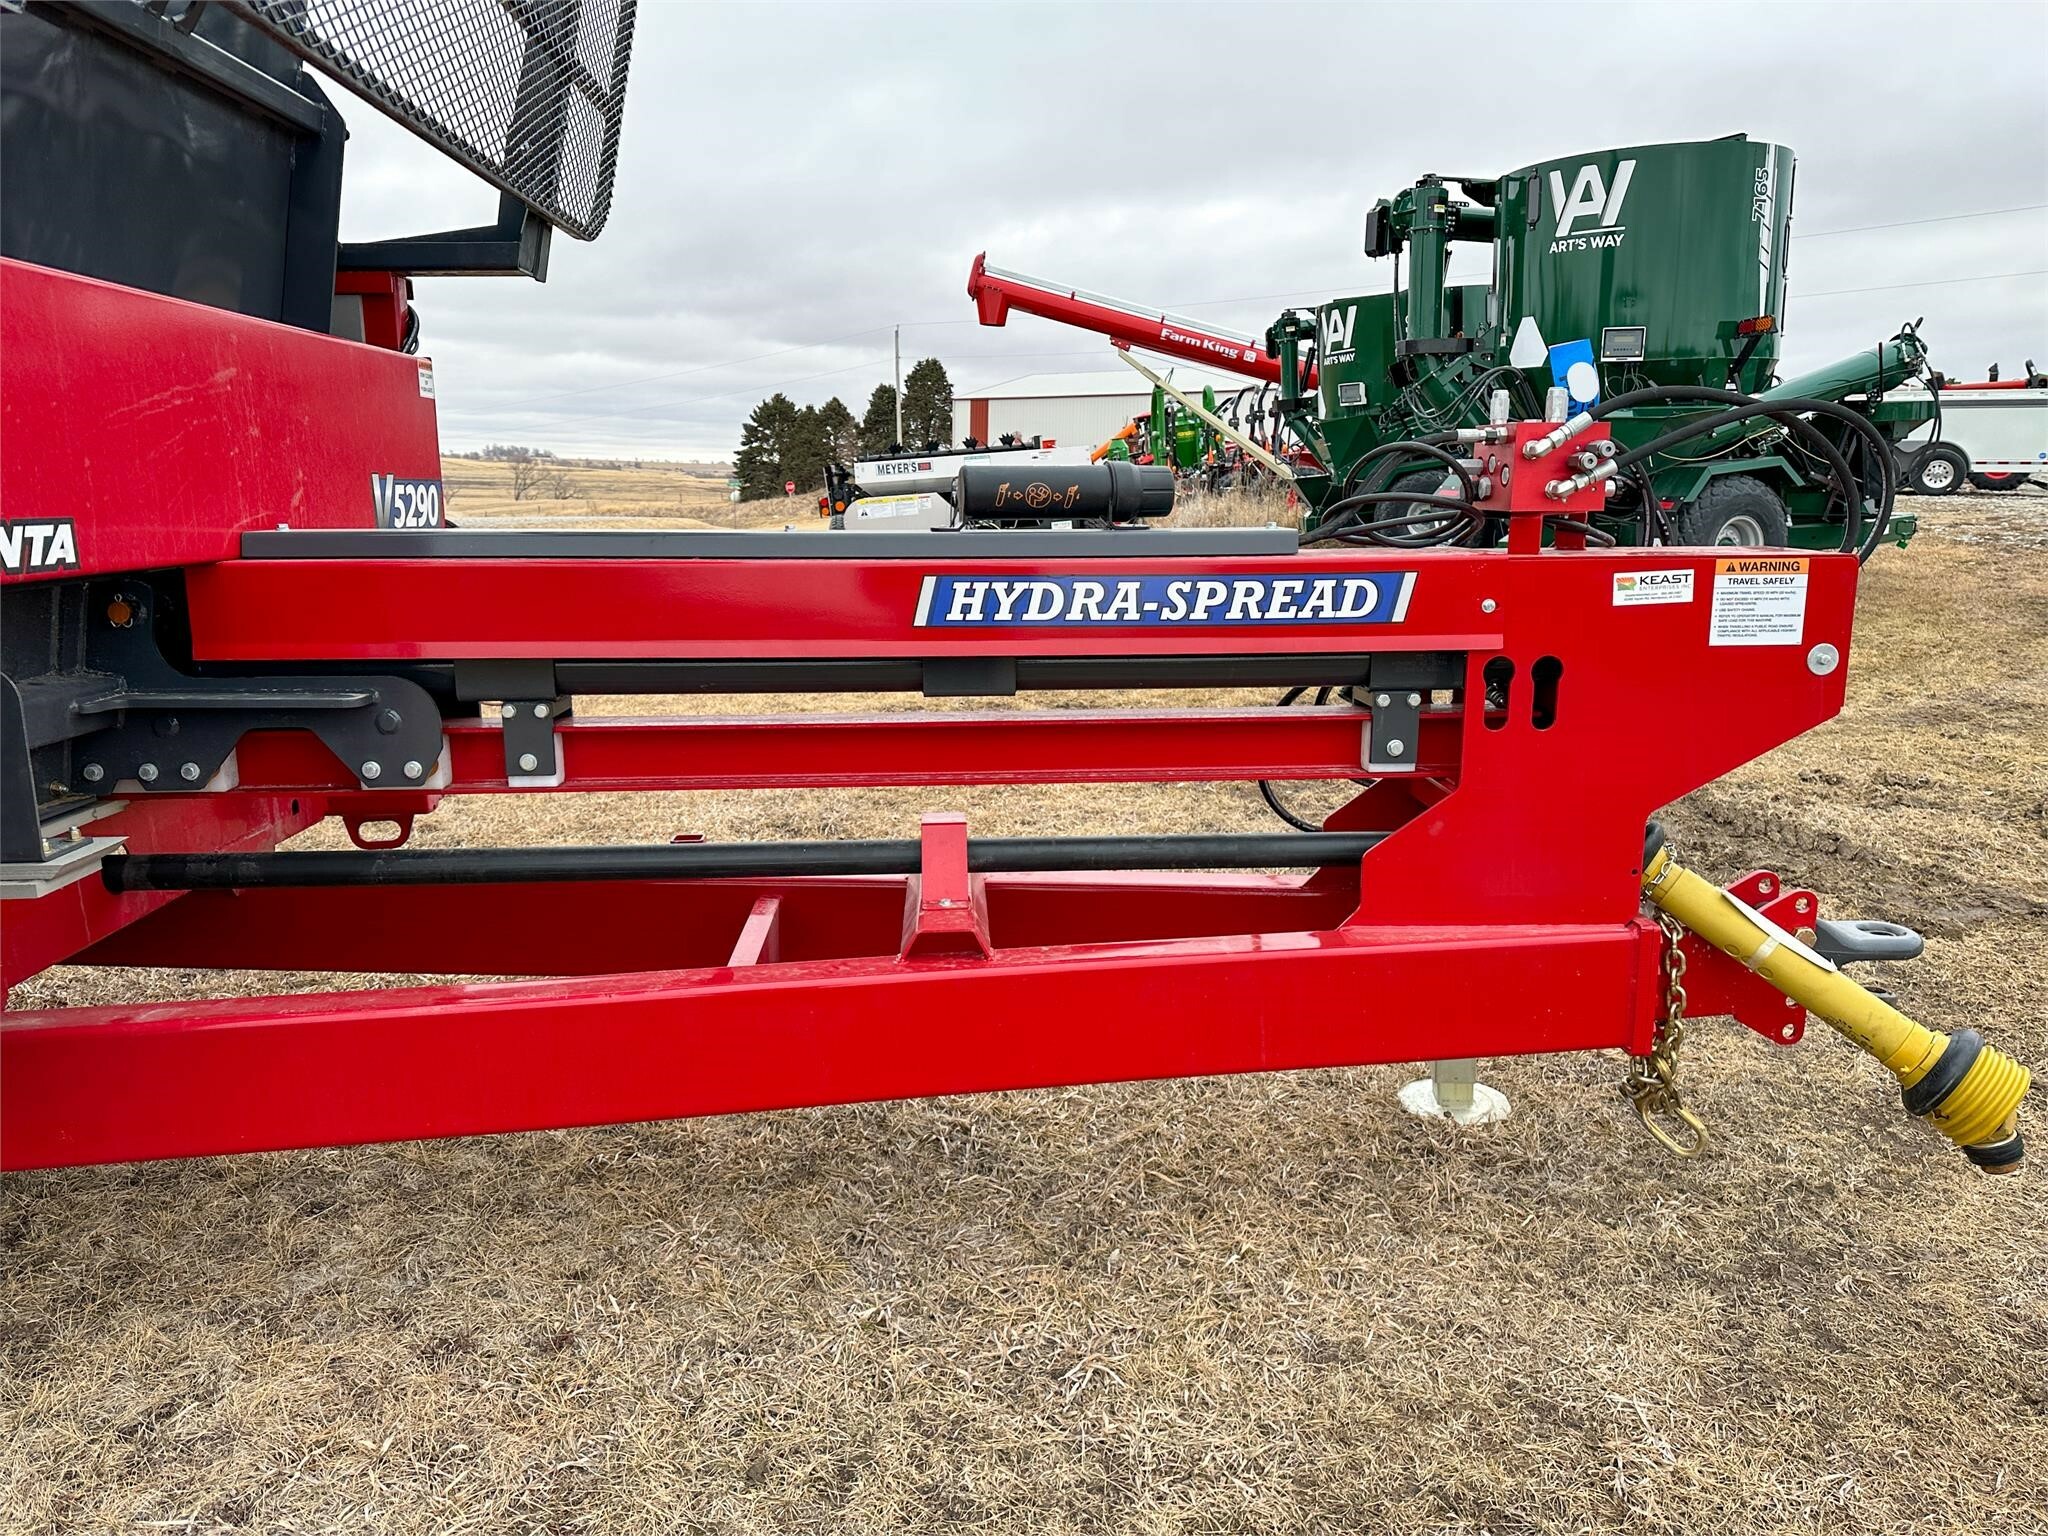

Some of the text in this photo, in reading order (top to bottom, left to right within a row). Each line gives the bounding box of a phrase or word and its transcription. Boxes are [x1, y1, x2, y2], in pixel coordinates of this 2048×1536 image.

[1751, 167, 1769, 222] 7165
[1549, 233, 1625, 254] ART'S WAY
[1160, 327, 1201, 348] Farm
[1202, 338, 1240, 360] King
[1323, 353, 1356, 366] ART'S WAY
[877, 462, 917, 476] MEYER'S
[371, 473, 439, 529] V5290
[0, 524, 77, 568] NTA
[1739, 561, 1800, 572] WARNING
[1640, 574, 1692, 585] KEAST
[1728, 577, 1795, 585] TRAVEL SAFELY
[944, 578, 1380, 622] HYDRA-SPREAD
